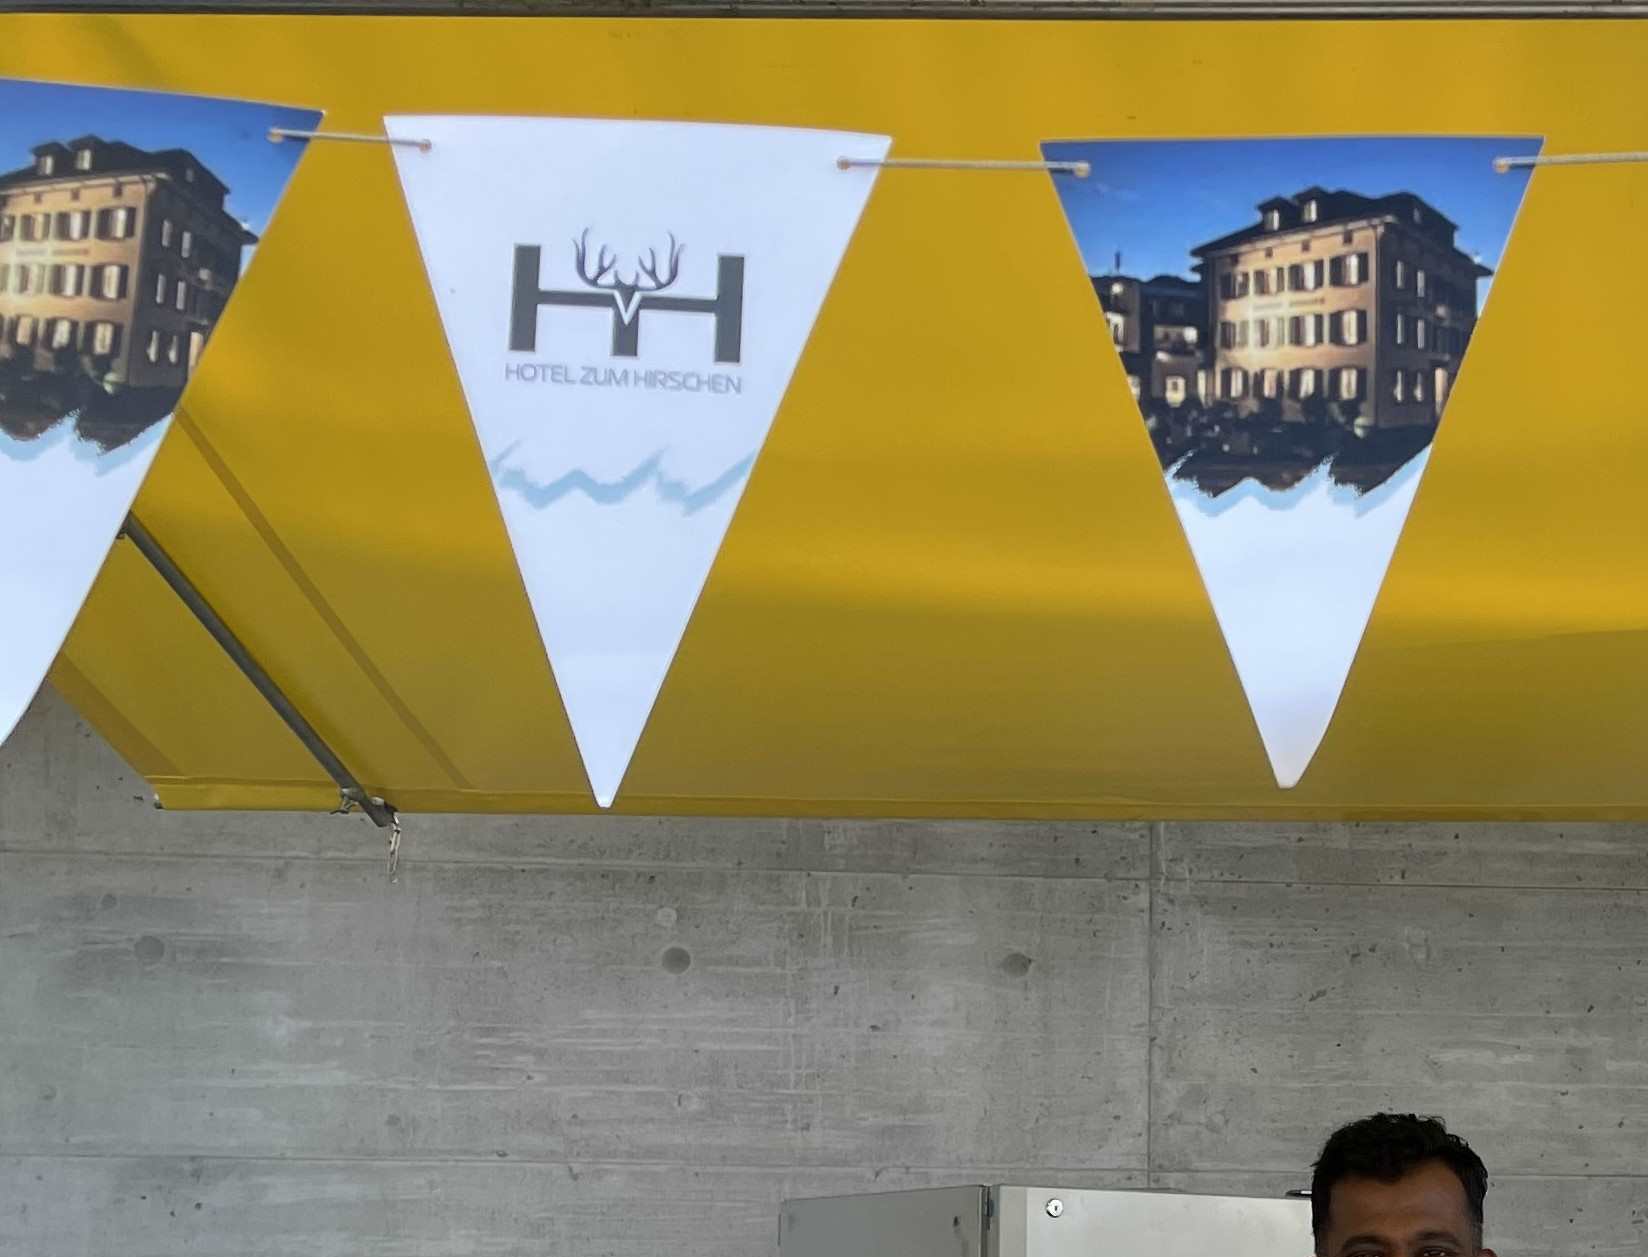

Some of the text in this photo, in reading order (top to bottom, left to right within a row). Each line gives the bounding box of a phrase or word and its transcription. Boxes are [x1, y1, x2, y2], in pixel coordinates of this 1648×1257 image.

[505, 363, 743, 394] HOTEL ZUM HIRSCHEN
